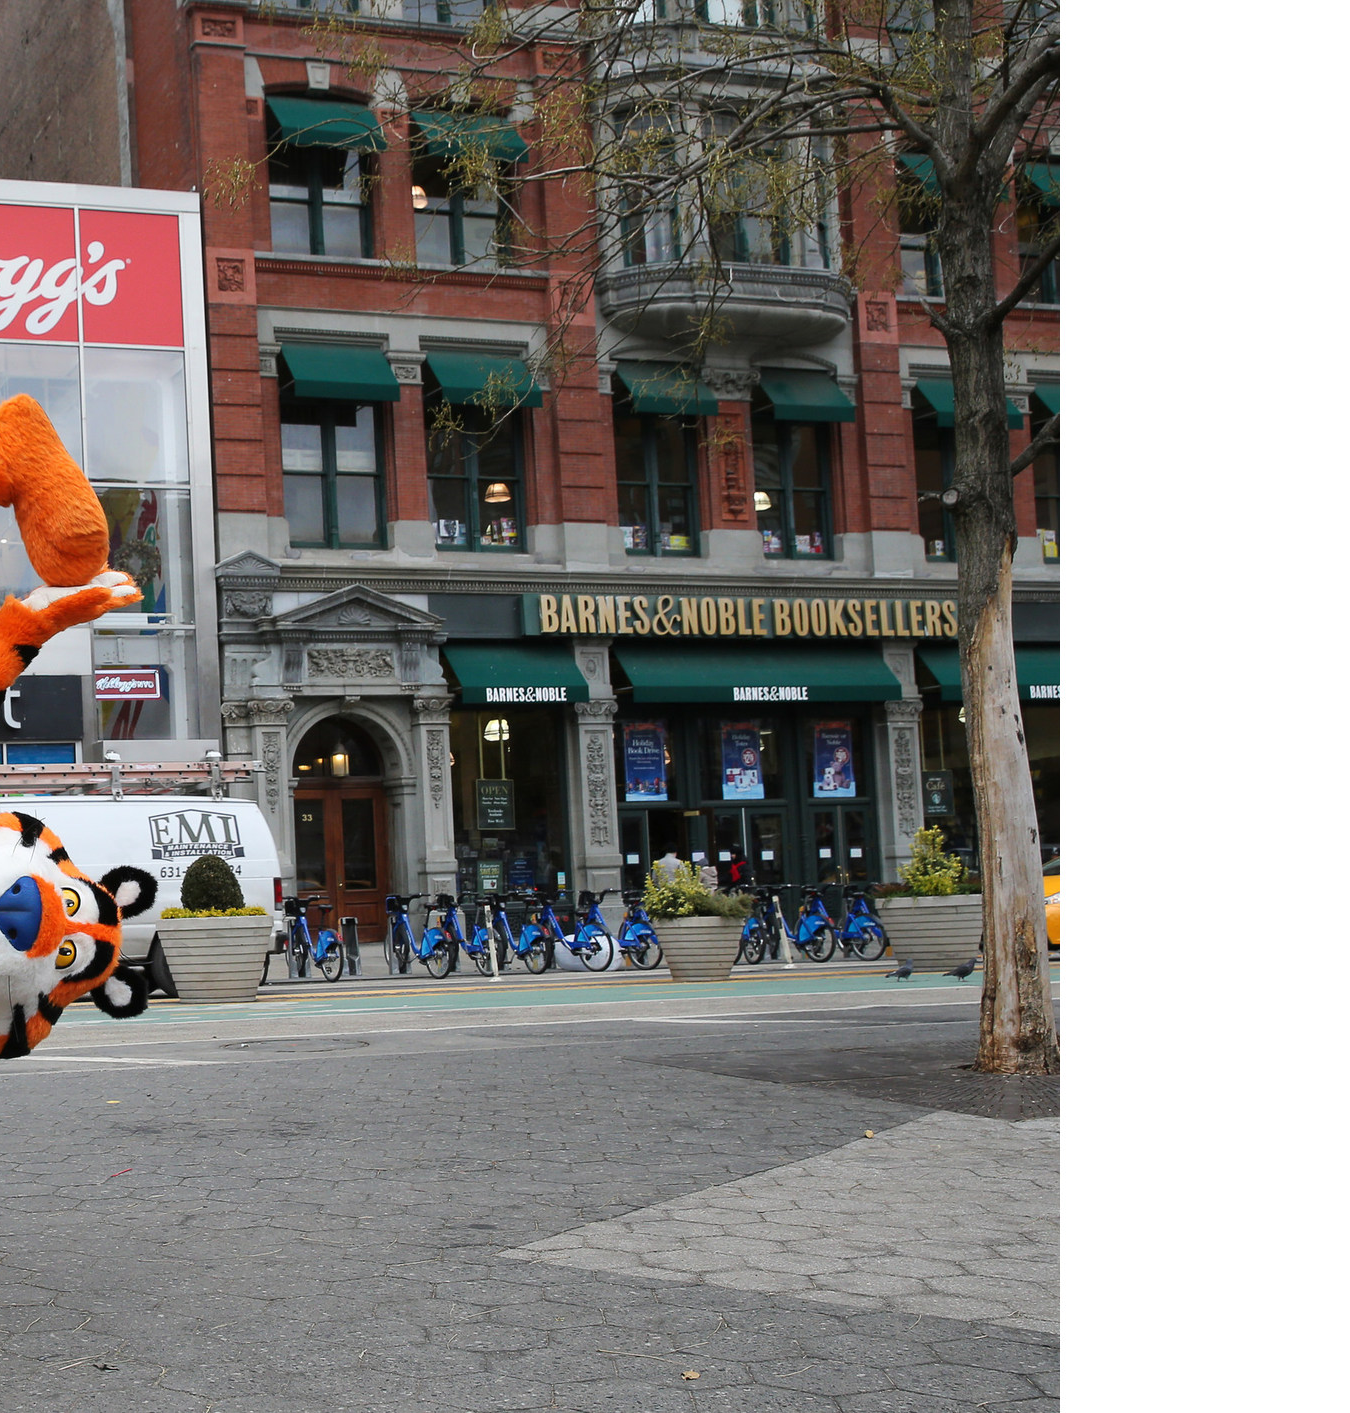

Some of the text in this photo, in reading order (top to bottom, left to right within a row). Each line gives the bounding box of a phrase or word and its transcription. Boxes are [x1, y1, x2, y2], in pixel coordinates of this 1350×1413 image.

[772, 600, 958, 637] BOOKSELLERS
[627, 747, 643, 755] Book
[480, 785, 508, 795] OPEN
[301, 813, 313, 822] 33
[152, 813, 236, 845] EMI
[171, 848, 232, 856] INSTALLATION
